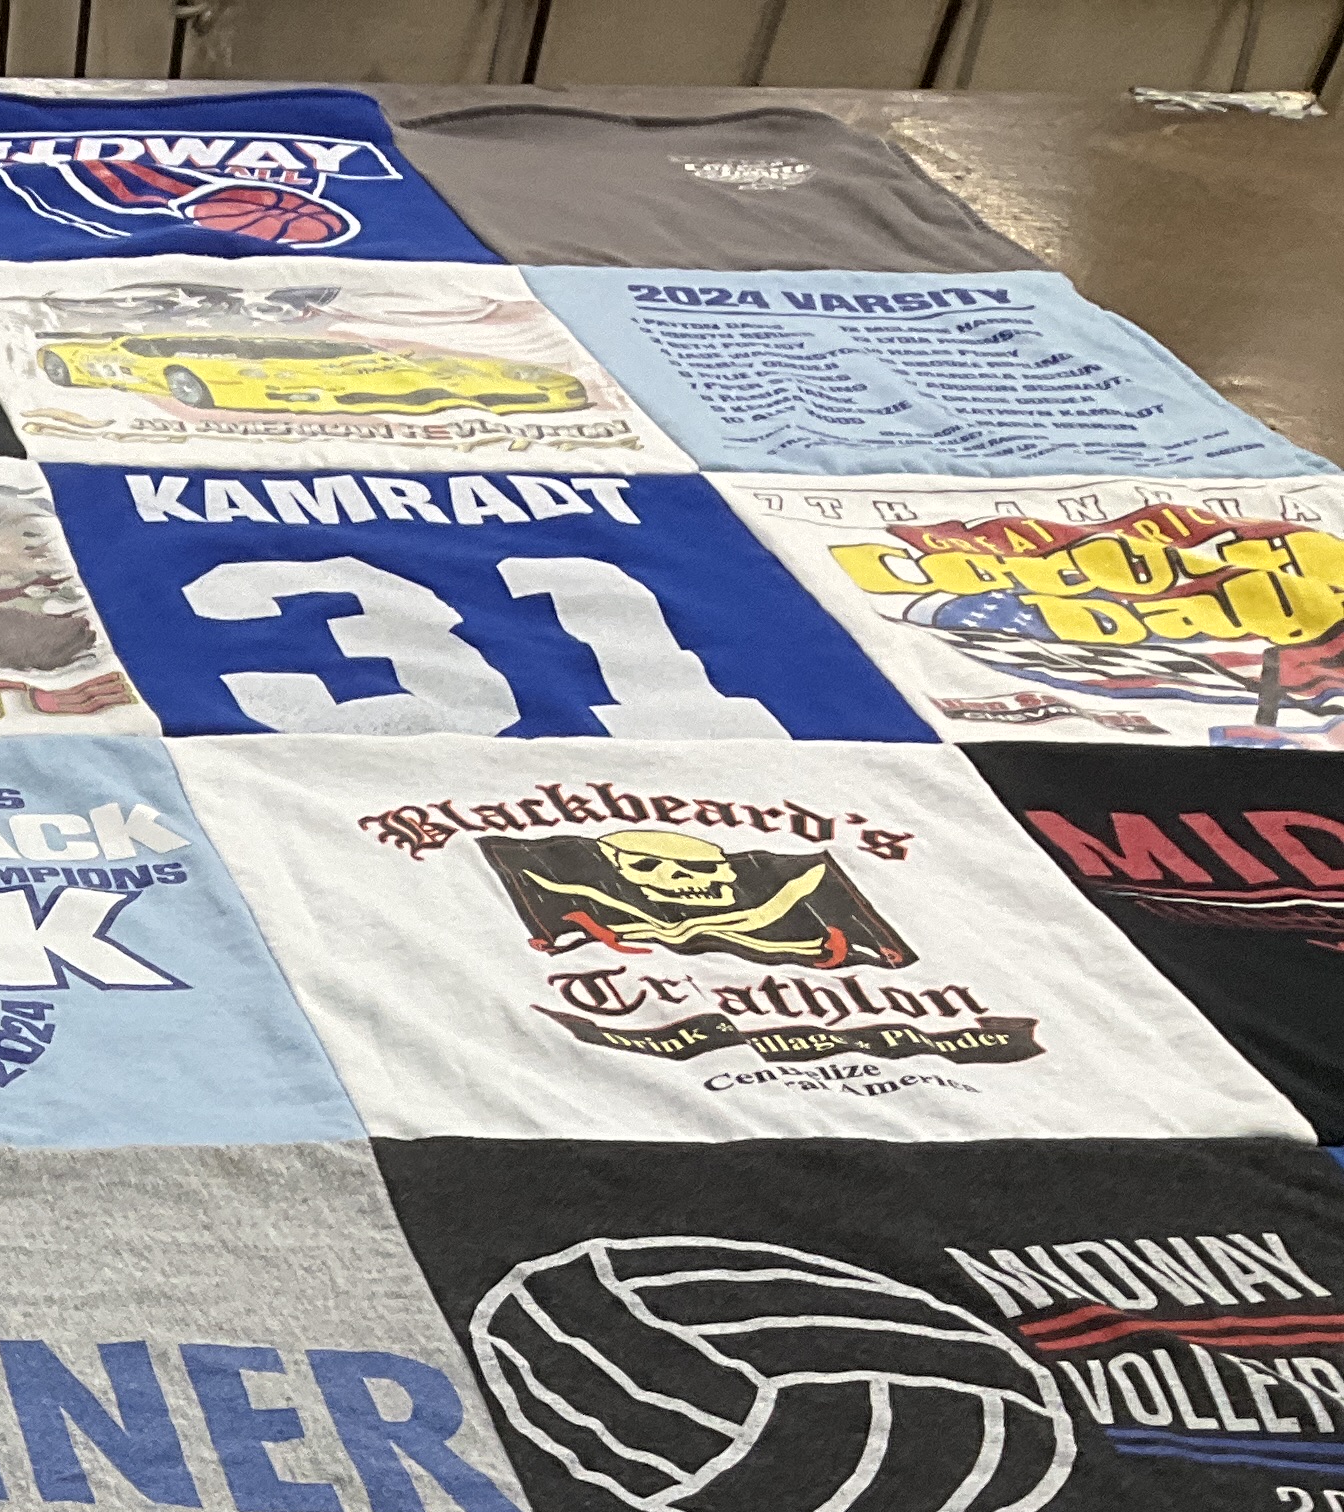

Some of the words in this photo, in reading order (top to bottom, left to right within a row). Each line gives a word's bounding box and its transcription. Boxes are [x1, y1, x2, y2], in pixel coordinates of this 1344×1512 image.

[627, 283, 771, 309] 2024
[781, 288, 1012, 314] VARSITY
[124, 473, 645, 525] KAMRADT
[181, 556, 793, 740] 31
[357, 782, 916, 862] Blackbeard's
[745, 1030, 850, 1054] illage
[944, 1232, 1332, 1318] MIDWAY
